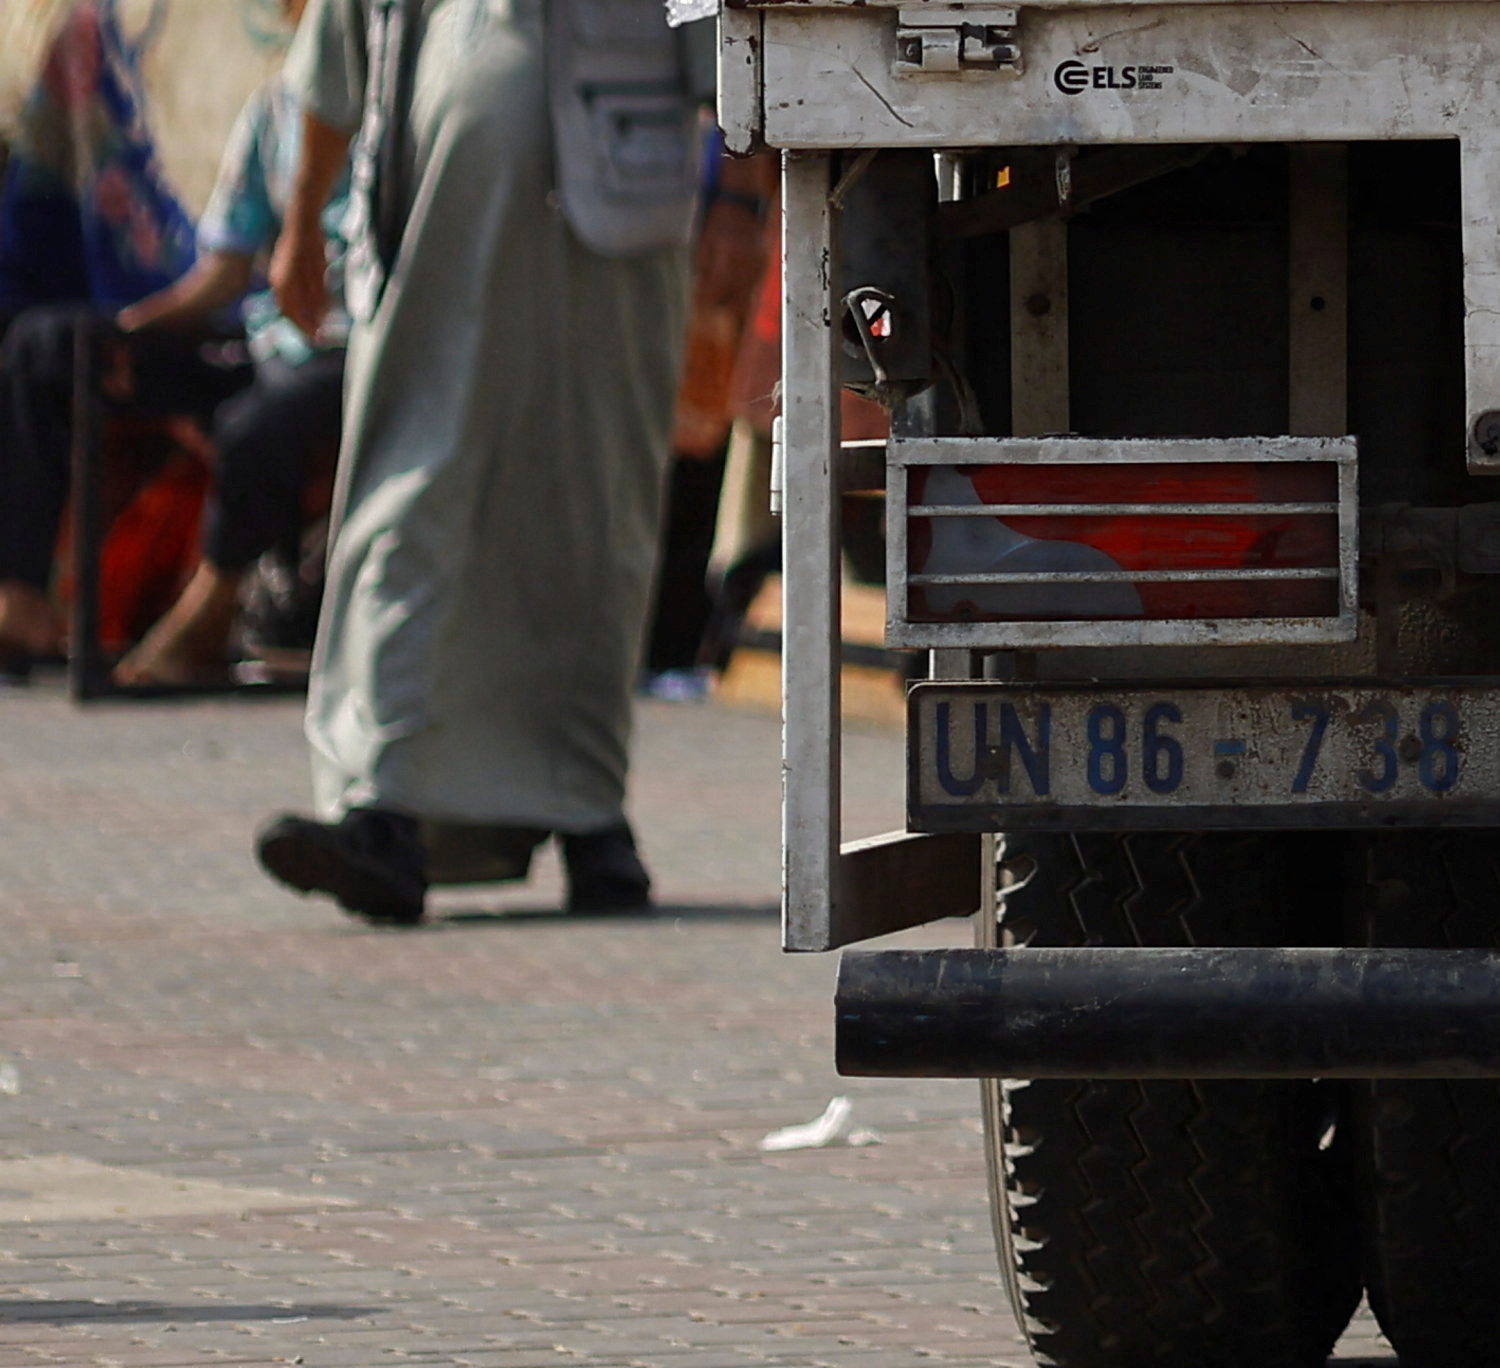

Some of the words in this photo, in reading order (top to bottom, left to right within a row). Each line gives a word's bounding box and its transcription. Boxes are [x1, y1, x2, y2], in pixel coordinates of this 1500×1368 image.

[1093, 66, 1137, 89] ELS
[935, 701, 1052, 797] UN
[1085, 700, 1185, 797] 86
